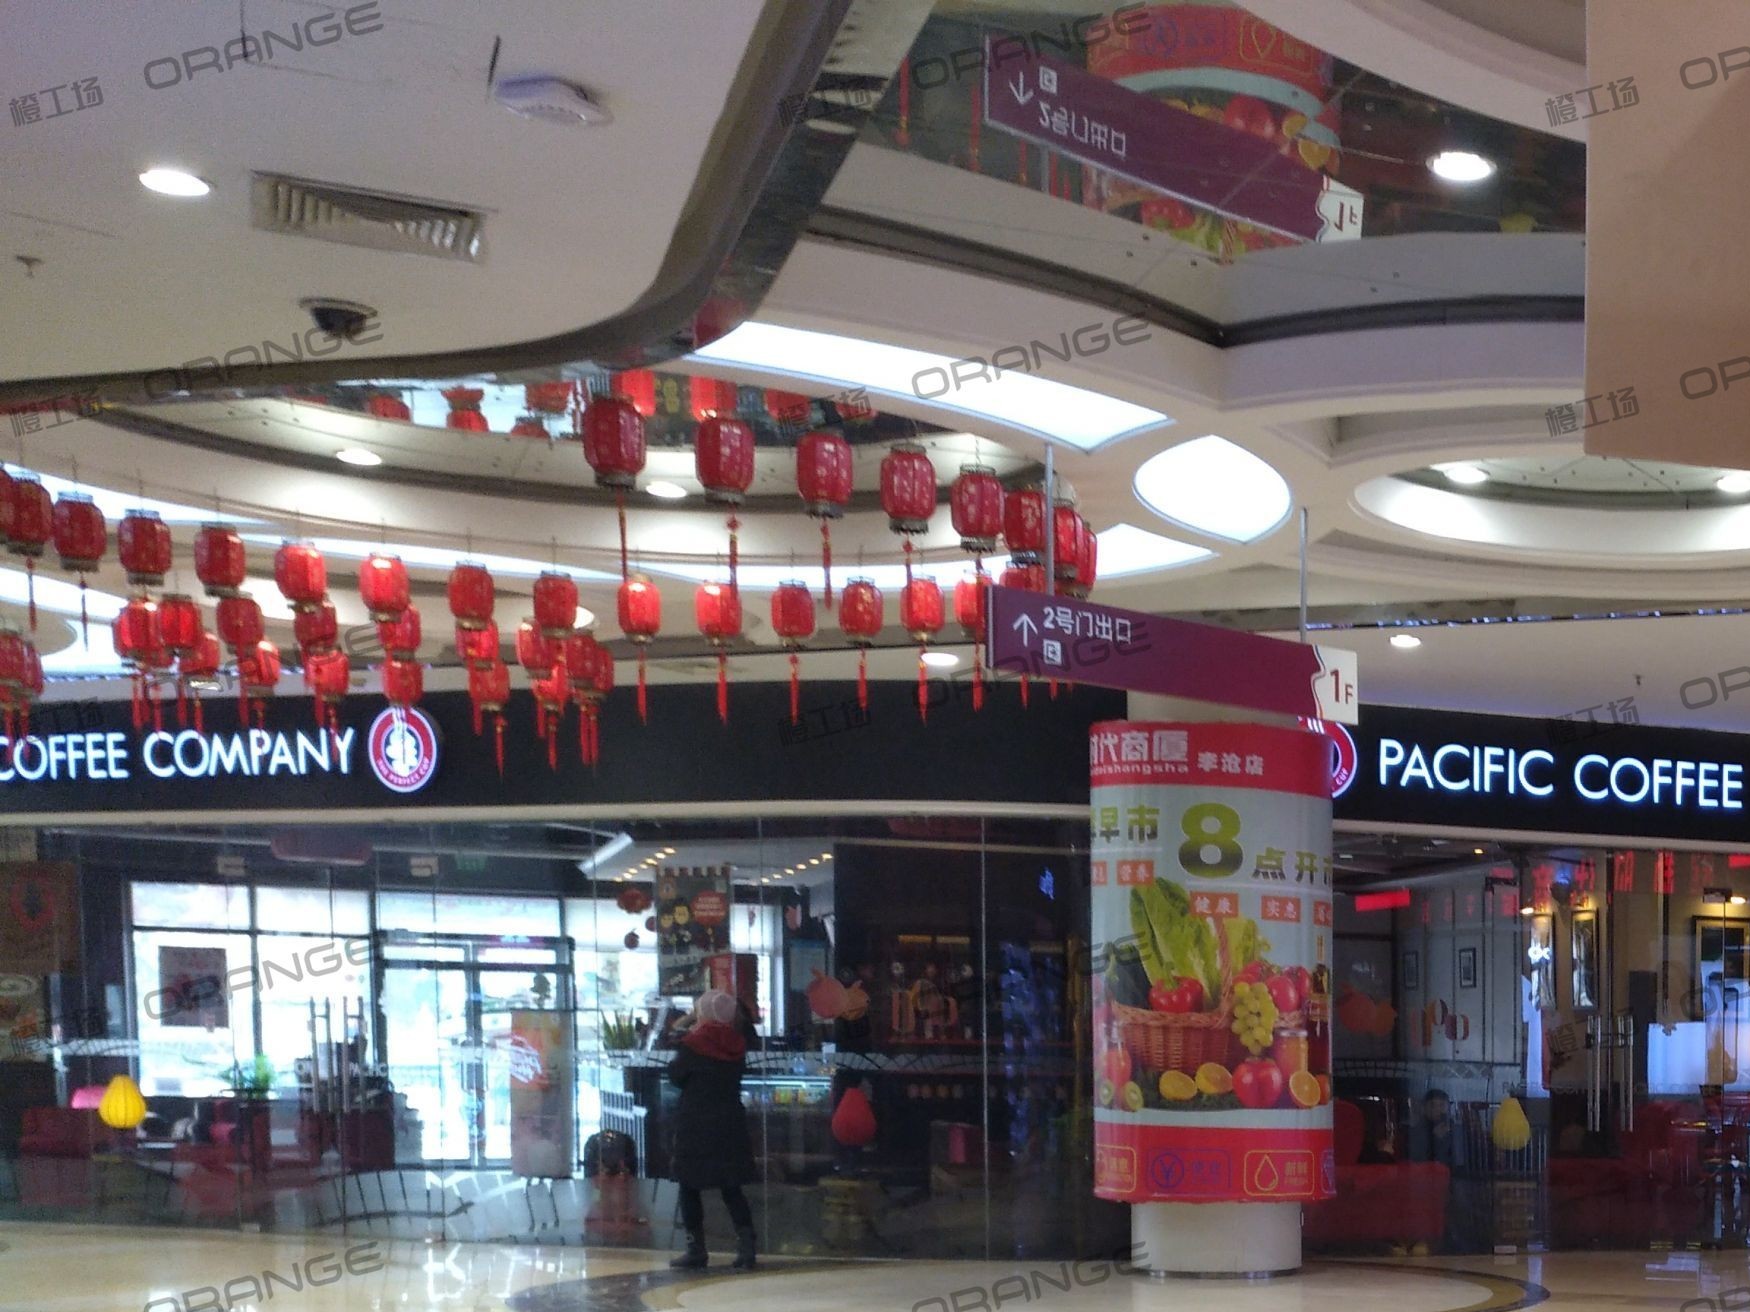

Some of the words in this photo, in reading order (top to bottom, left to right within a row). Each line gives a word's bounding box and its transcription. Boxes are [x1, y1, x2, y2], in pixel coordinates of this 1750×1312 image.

[1043, 606, 1132, 645] 2号门出口
[1329, 668, 1354, 705] 1F
[143, 727, 355, 778] COMPANY
[1379, 738, 1555, 797] PACIFIC
[1573, 753, 1744, 809] COFFEE
[1091, 804, 1160, 844] 早市
[1178, 802, 1244, 879] 8
